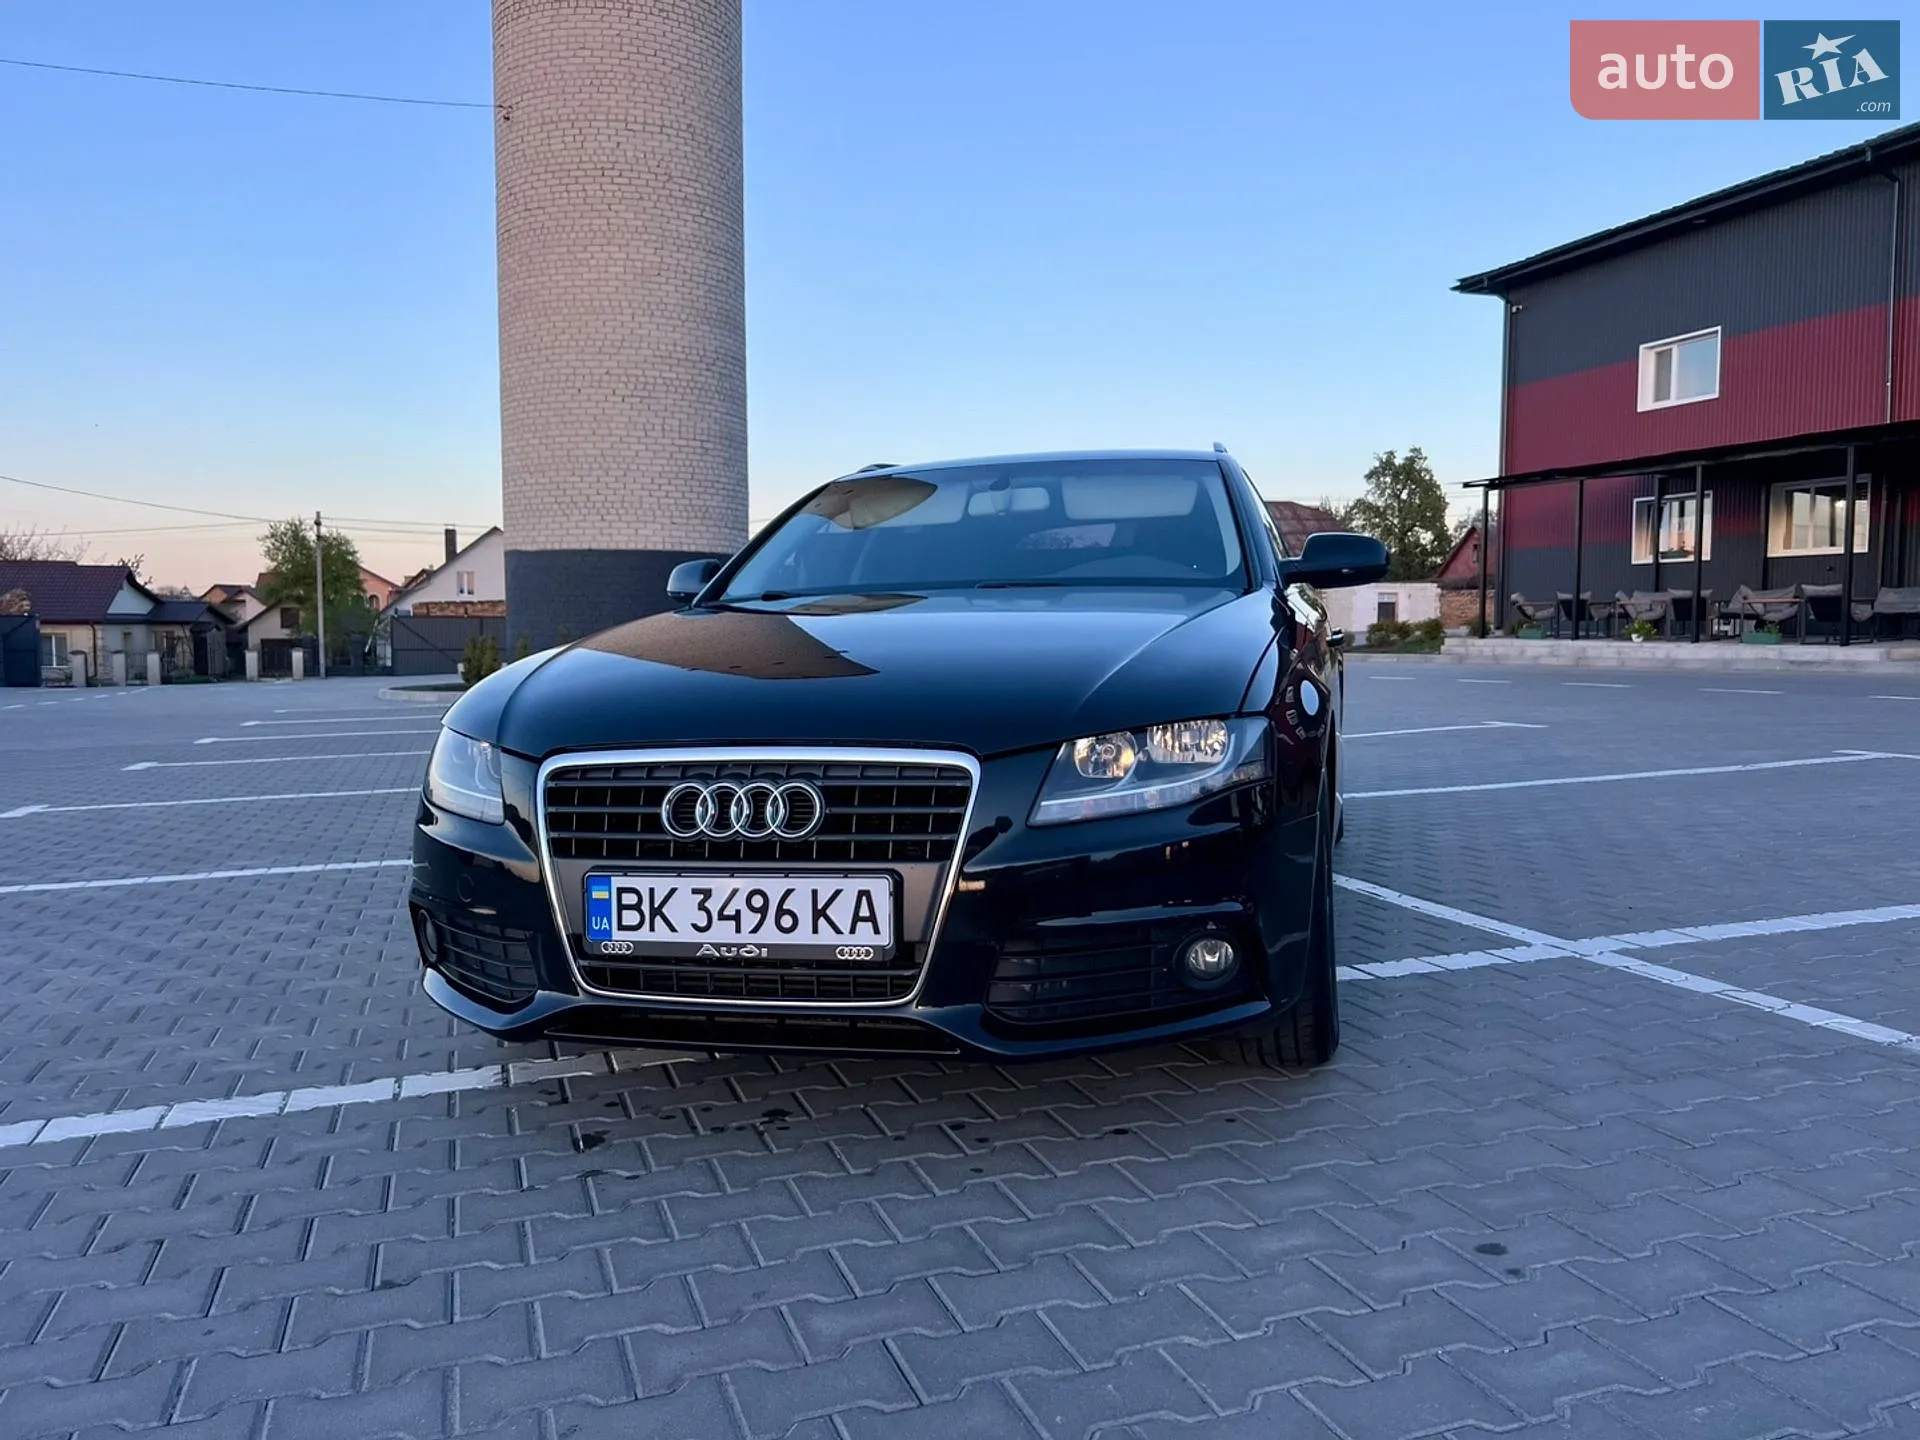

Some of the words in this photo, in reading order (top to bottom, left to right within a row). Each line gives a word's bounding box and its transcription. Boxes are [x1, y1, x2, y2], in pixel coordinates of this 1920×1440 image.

[592, 917, 610, 930] UA
[616, 886, 679, 933] BK
[690, 887, 800, 935] 3496
[811, 888, 882, 935] KA
